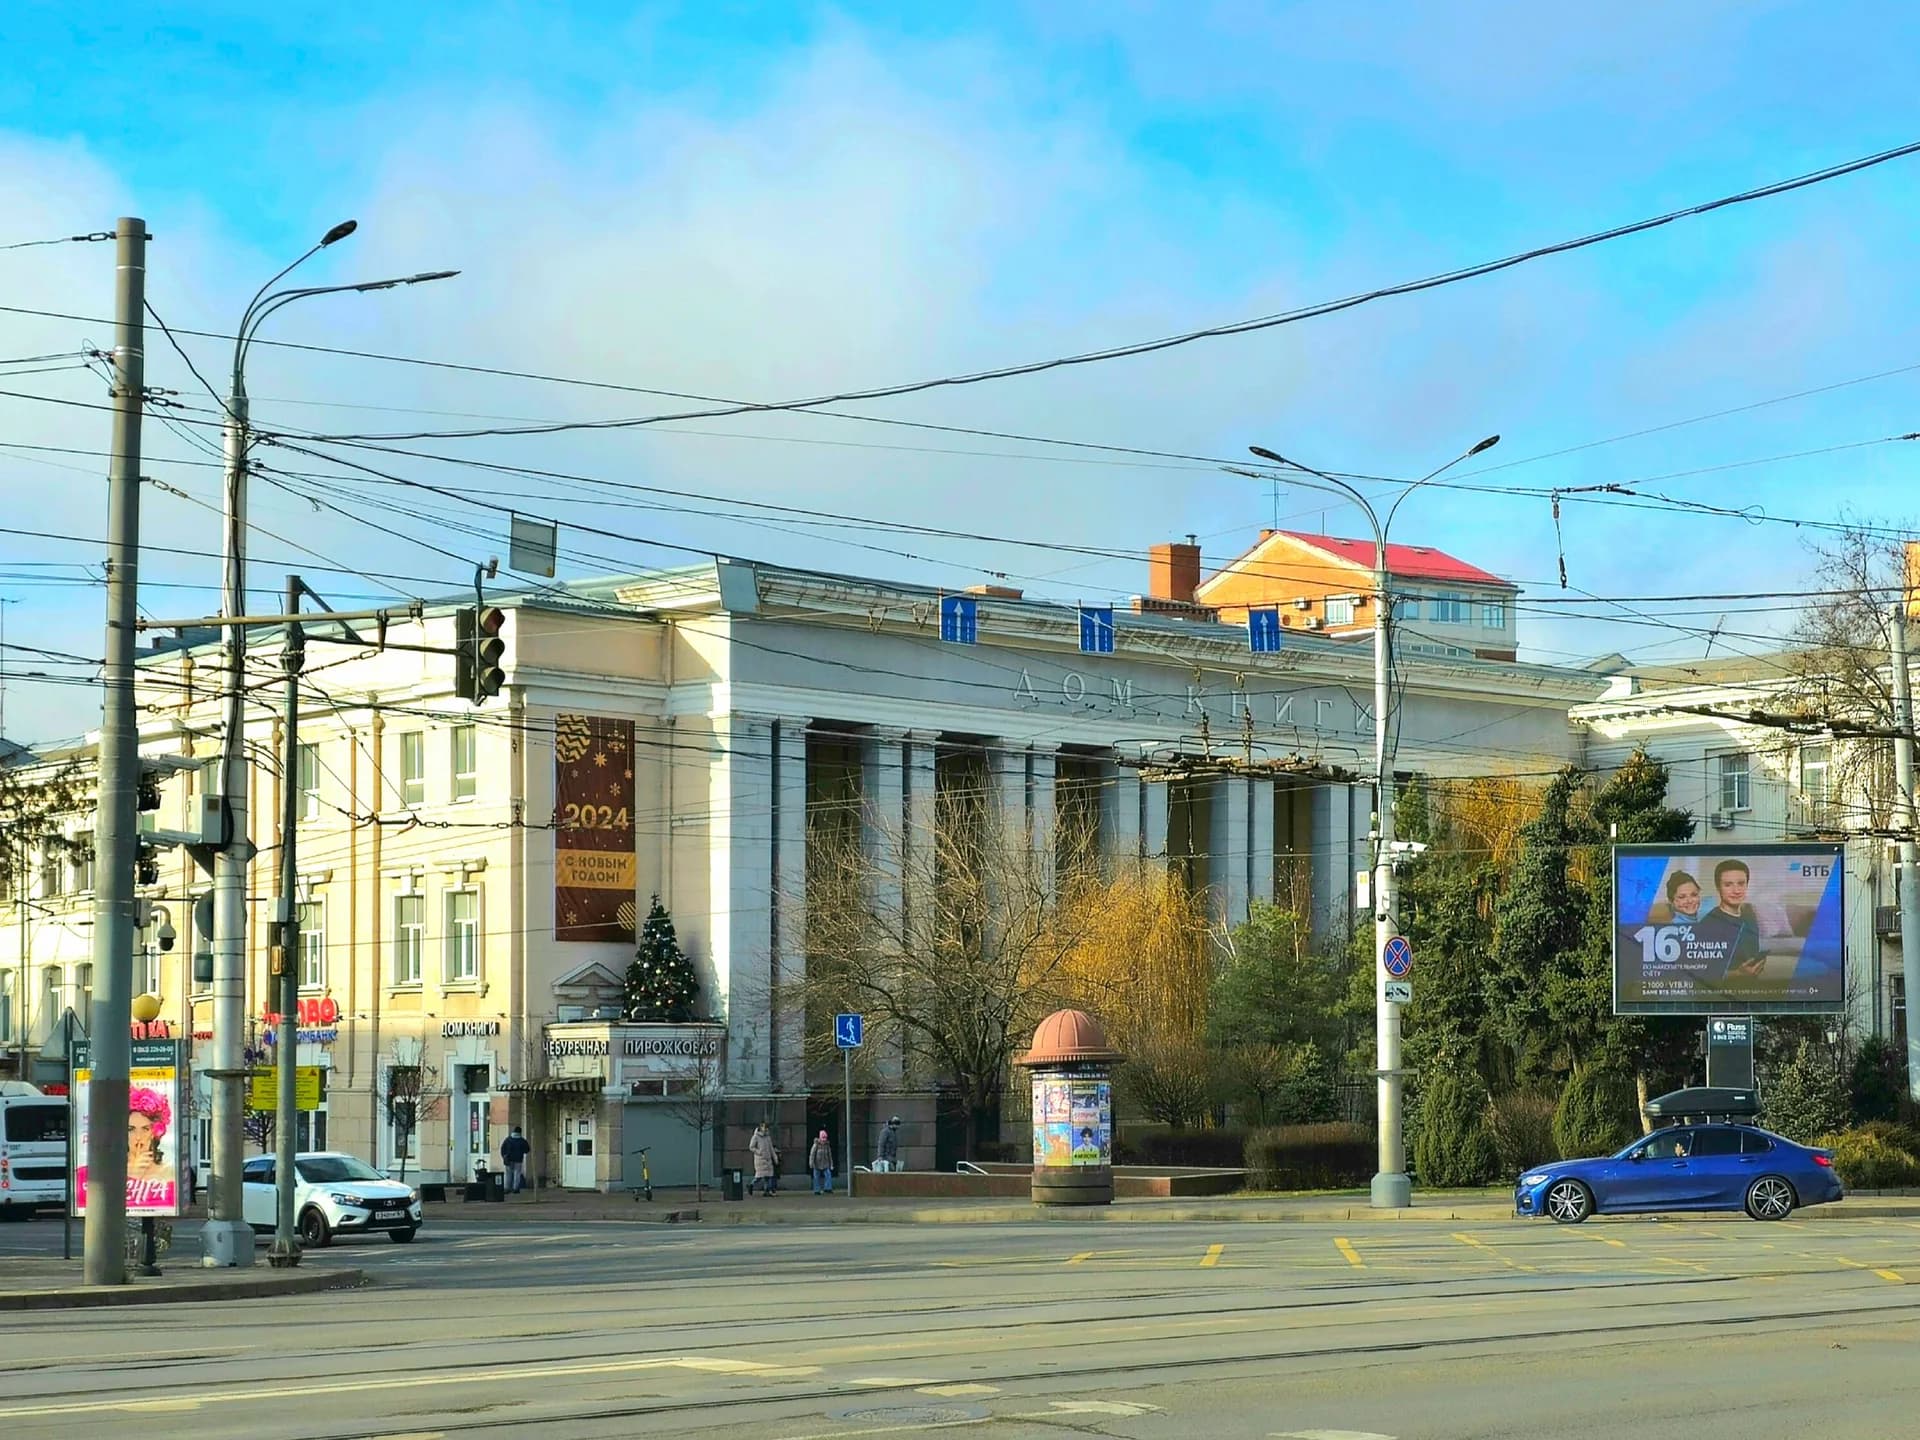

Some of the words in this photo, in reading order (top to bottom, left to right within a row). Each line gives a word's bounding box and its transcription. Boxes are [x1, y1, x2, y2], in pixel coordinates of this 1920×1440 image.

[1013, 667, 1132, 709] ДОМ
[1185, 685, 1375, 732] КНИГИ
[562, 803, 629, 831] 2024
[565, 856, 574, 867] С
[578, 856, 627, 869] НОВЫМ
[571, 869, 620, 883] ГОДОМ!
[1802, 864, 1830, 877] ВТБ
[1686, 942, 1728, 950] ЛУЧШАЯ
[1686, 951, 1724, 959] СТАВКА
[442, 1021, 463, 1038] ДОМ
[465, 1021, 497, 1037] КНИГИ
[543, 1040, 607, 1056] ЧЕБУРЕЧНАЯ
[625, 1040, 717, 1055] ПИРОЖКОВАЯ
